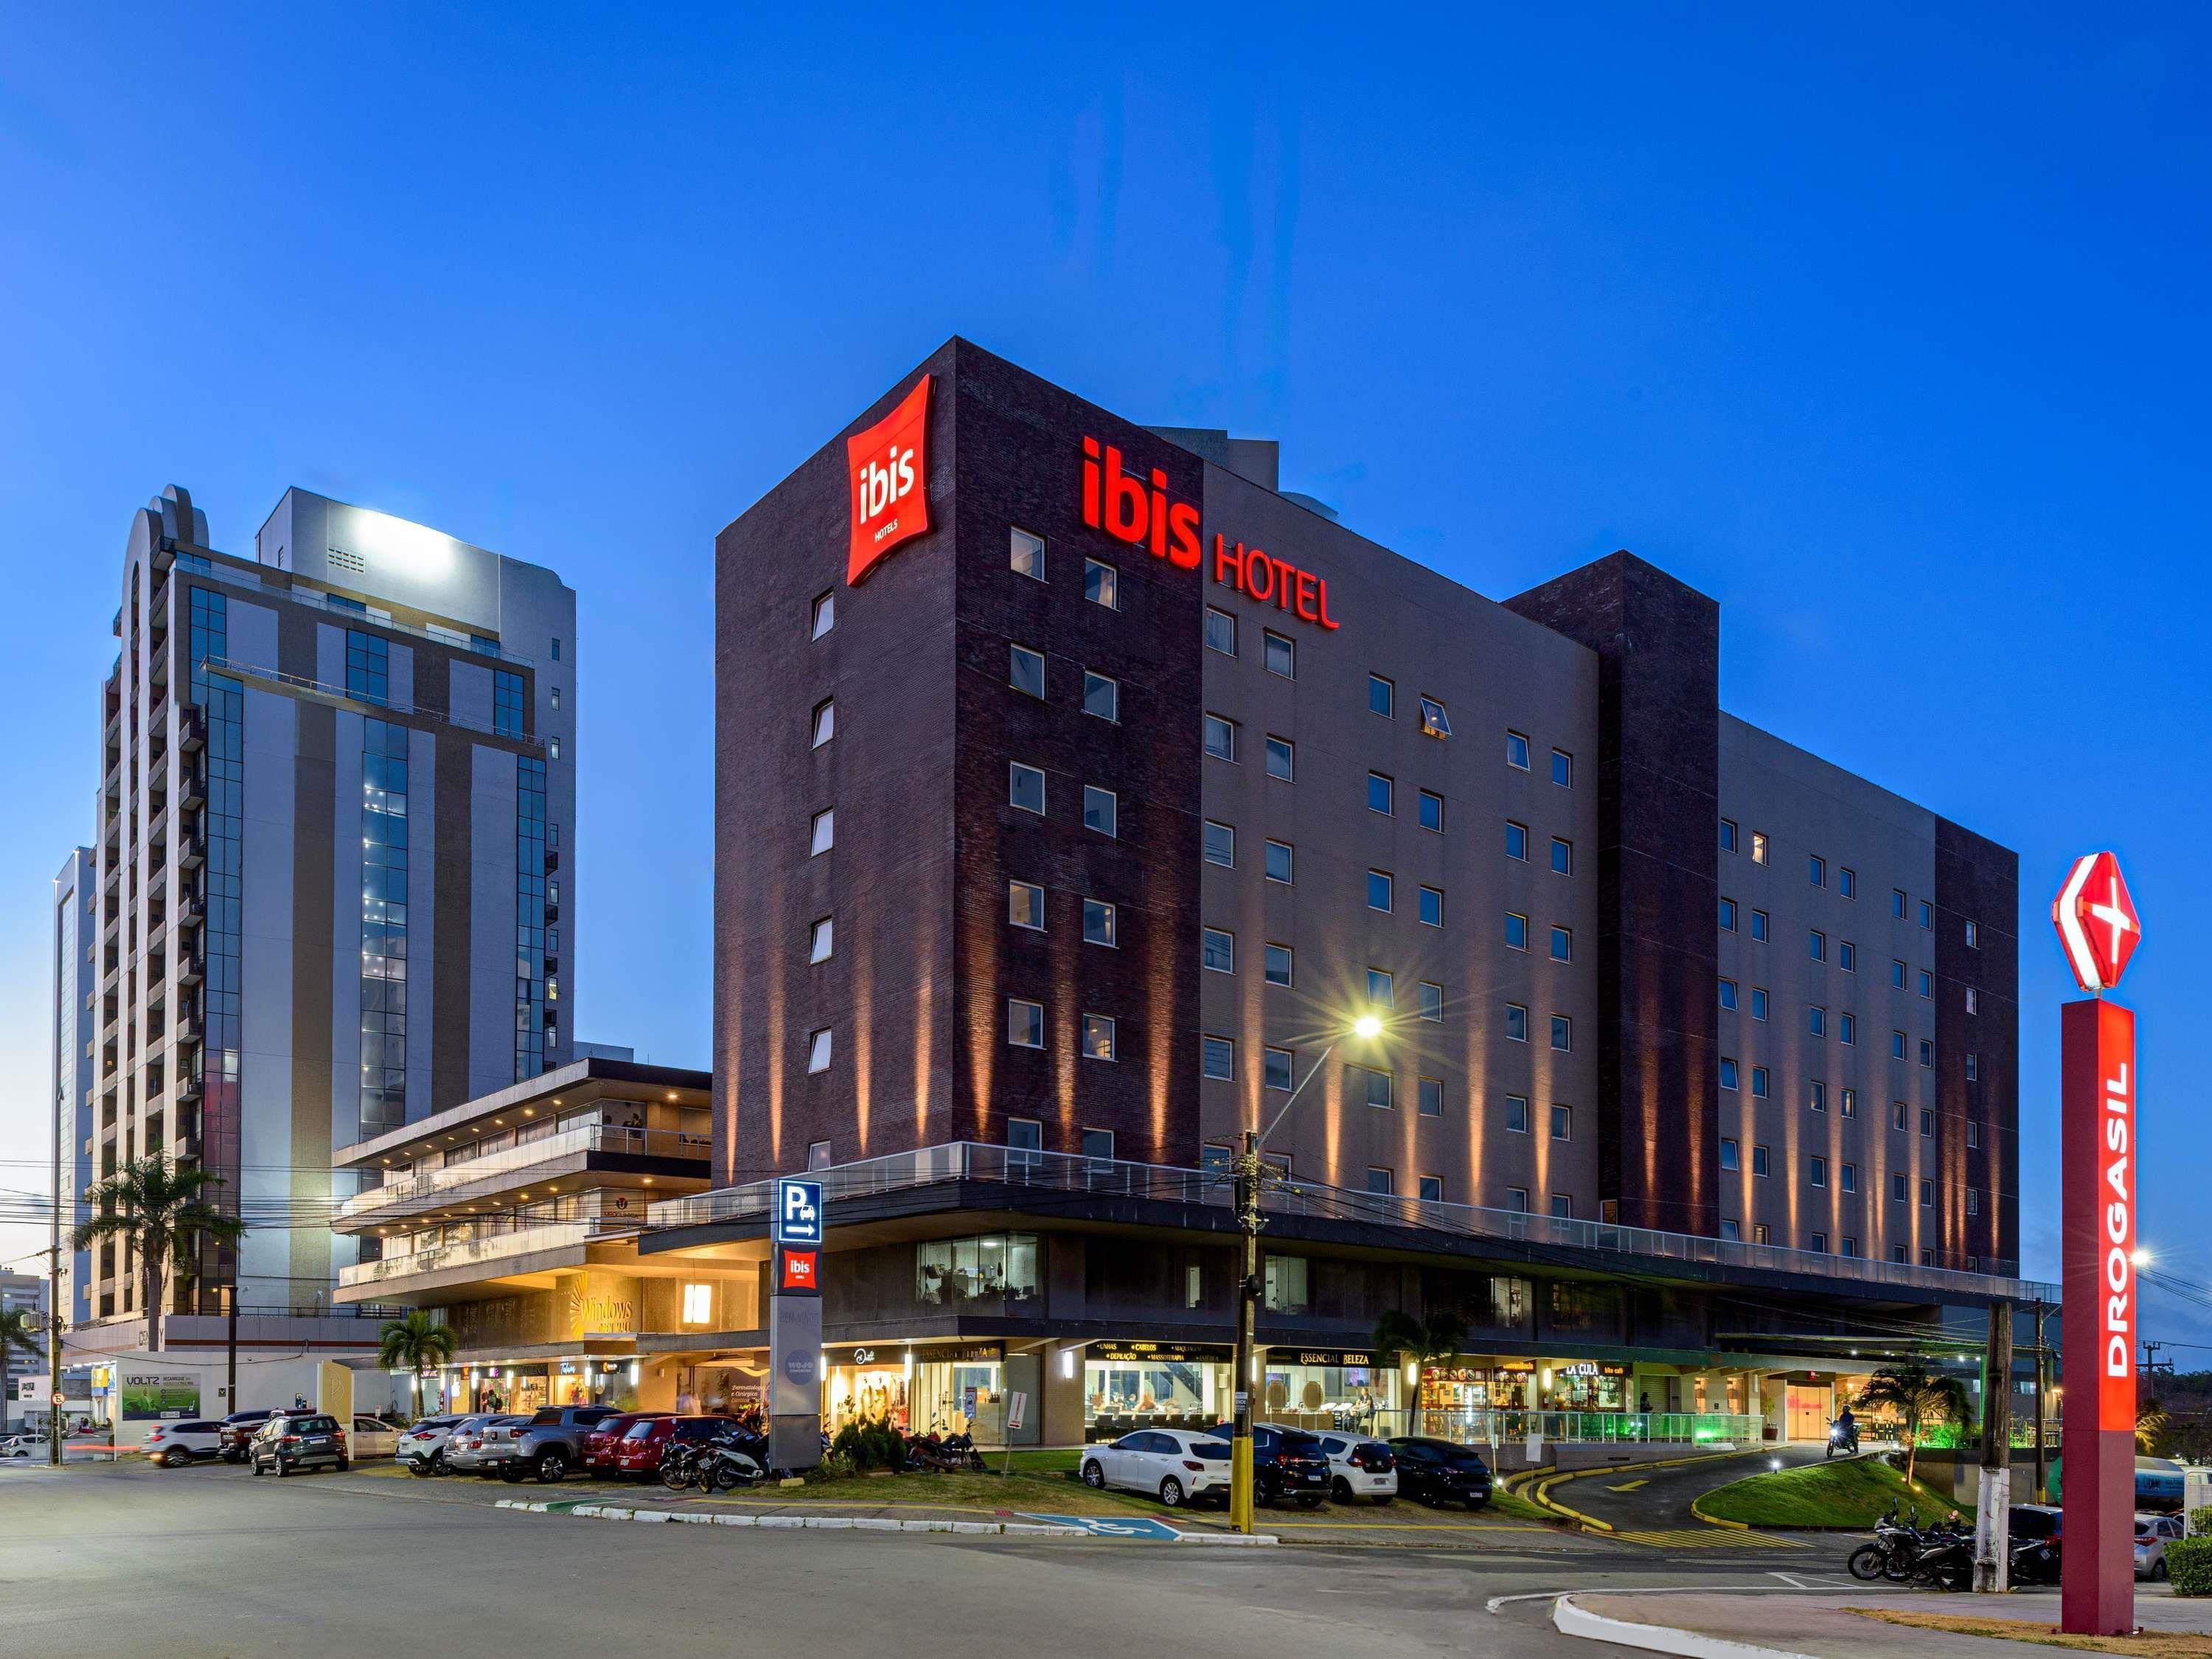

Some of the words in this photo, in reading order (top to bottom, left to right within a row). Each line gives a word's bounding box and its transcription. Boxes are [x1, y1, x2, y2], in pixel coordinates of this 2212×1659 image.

[860, 445, 914, 524] ibis
[874, 518, 898, 543] HOTELS
[1083, 436, 1201, 569] ibis
[1215, 534, 1340, 630] HOTEL
[2107, 1062, 2128, 1377] DROGASIL
[790, 1259, 810, 1273] ibis
[580, 1295, 632, 1322] Windows
[1135, 1343, 1157, 1352] CABELOS
[1110, 1352, 1136, 1361] DEPILAÇÃO
[1300, 1352, 1339, 1365] ESSENCIAL
[1343, 1354, 1369, 1365] BELEZA
[1566, 1365, 1576, 1375] LA
[127, 1377, 160, 1387] VOLTZ
